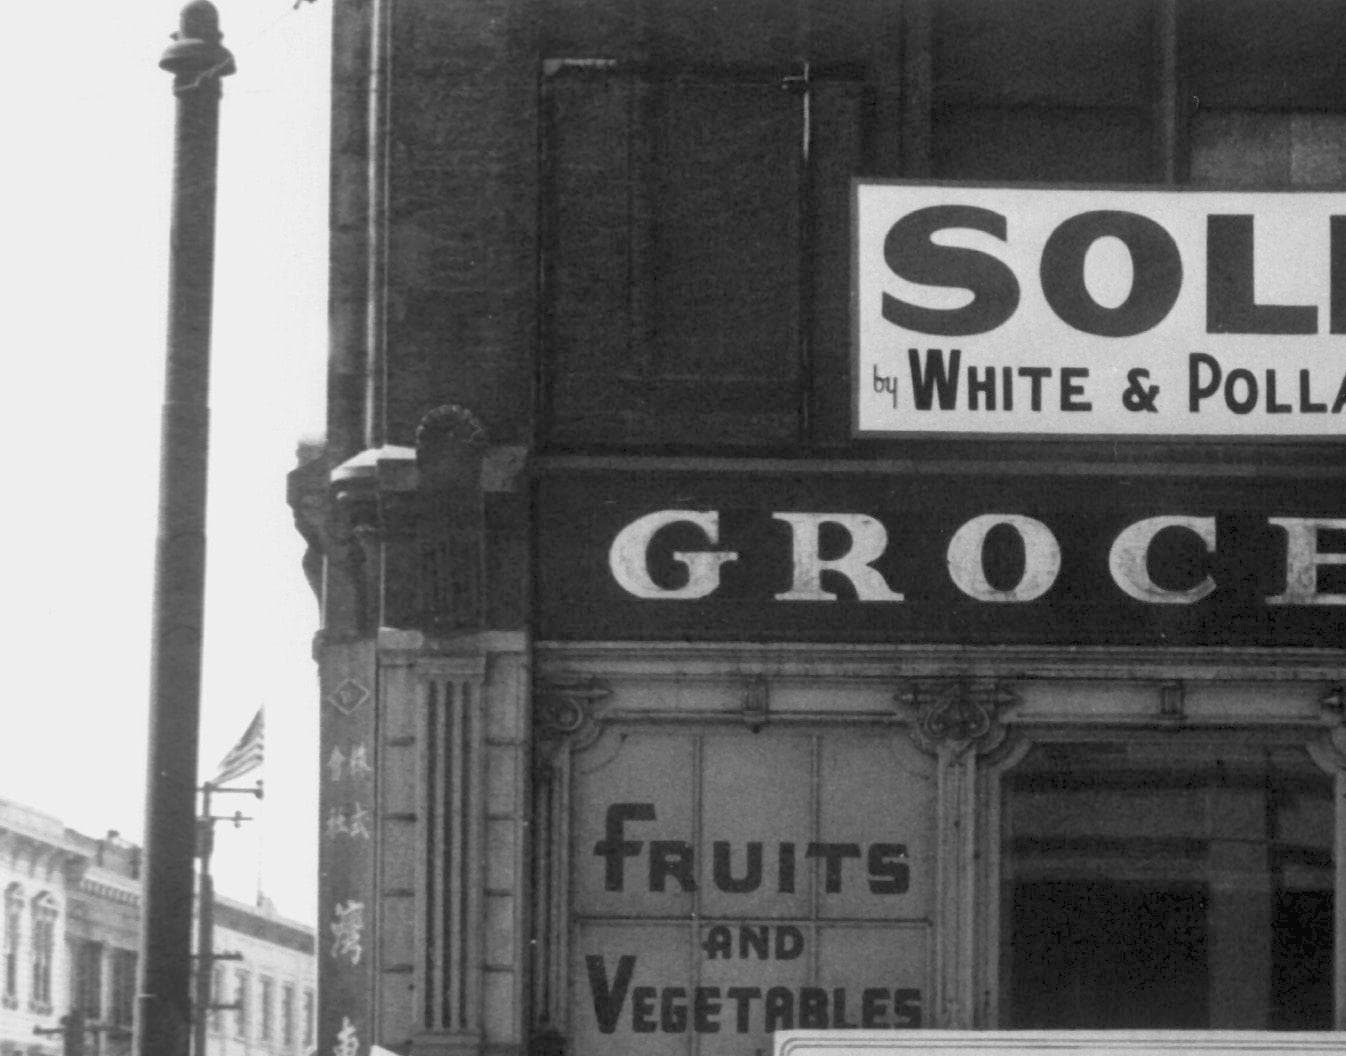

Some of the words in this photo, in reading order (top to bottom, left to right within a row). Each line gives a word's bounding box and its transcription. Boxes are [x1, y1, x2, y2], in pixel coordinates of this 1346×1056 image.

[872, 364, 898, 410] by
[1120, 366, 1161, 414] &
[703, 924, 805, 960] AND
[585, 954, 923, 1035] VEGETABLES
